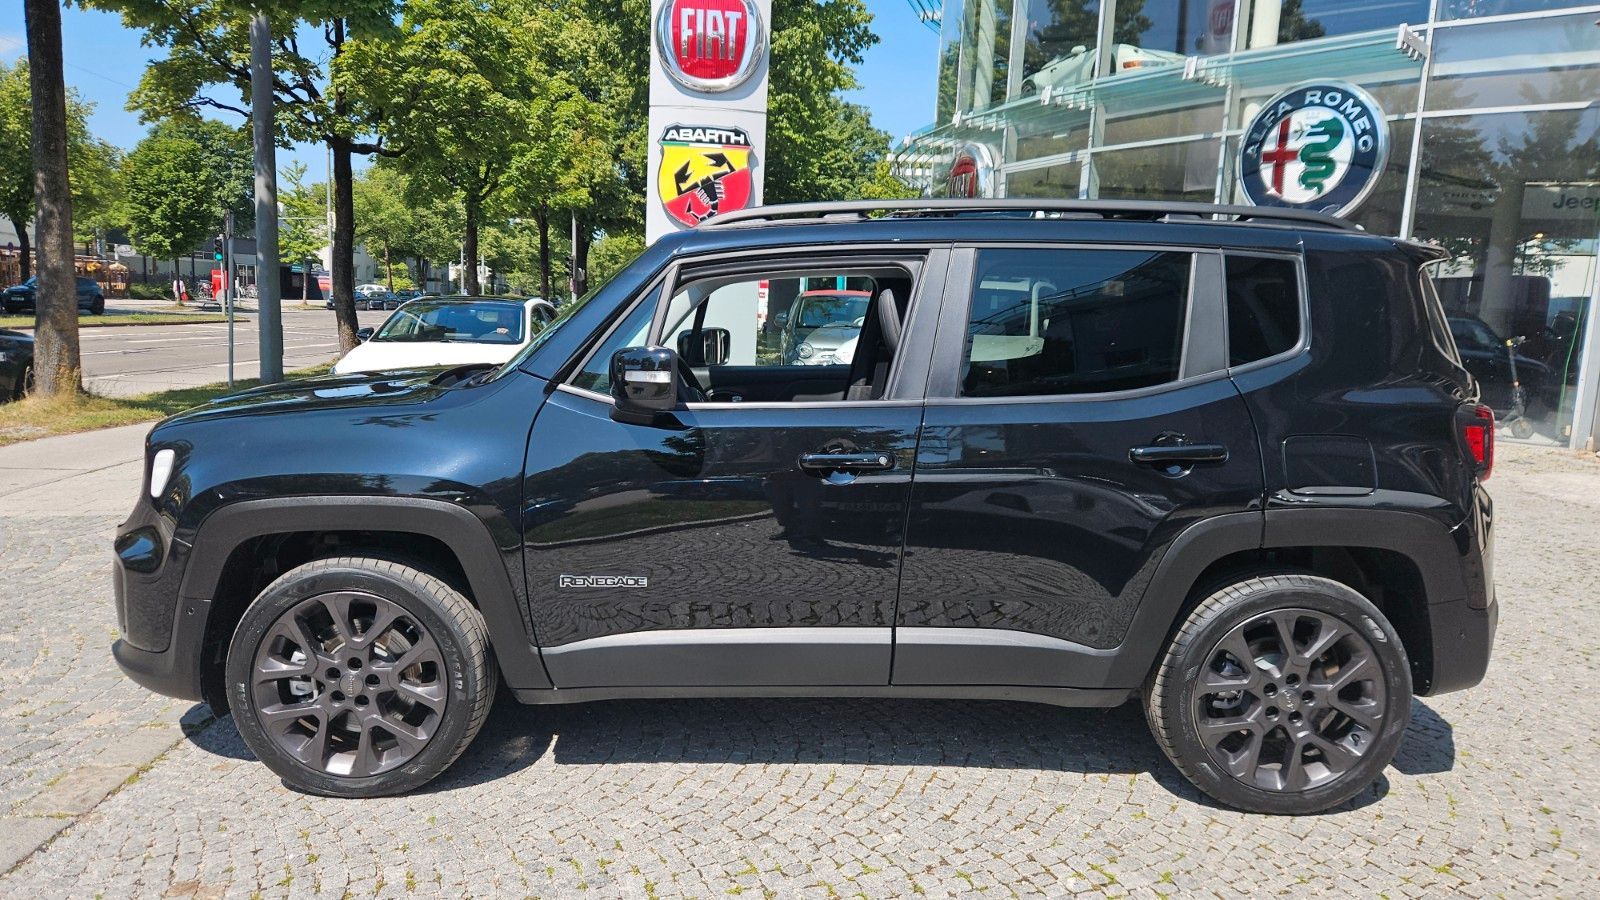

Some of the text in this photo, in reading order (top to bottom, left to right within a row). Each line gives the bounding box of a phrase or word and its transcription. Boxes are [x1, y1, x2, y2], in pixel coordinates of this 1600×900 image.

[681, 8, 742, 60] FIAT
[665, 128, 745, 145] ABARTH
[1246, 90, 1374, 159] ALFA ROMEO
[560, 575, 648, 588] RENEGADE
